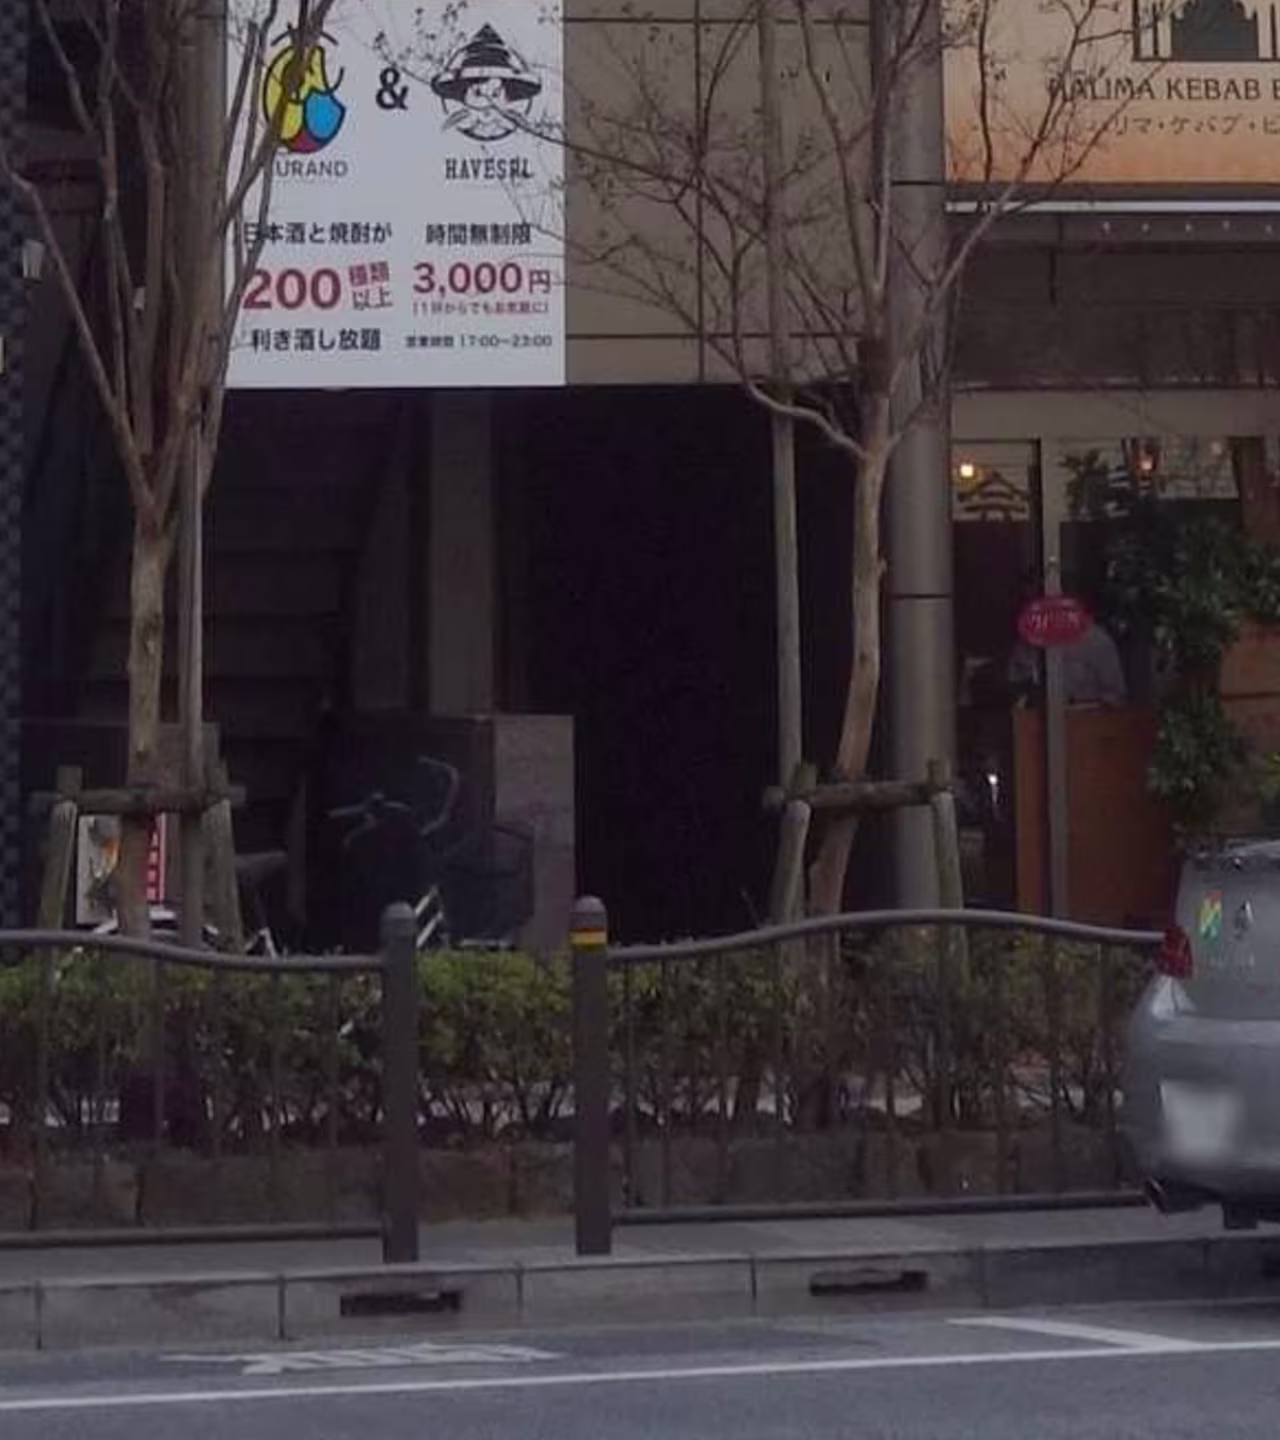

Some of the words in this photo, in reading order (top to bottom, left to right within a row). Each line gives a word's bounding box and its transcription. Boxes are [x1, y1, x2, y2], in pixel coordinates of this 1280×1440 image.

[376, 67, 408, 111] &
[1166, 76, 1261, 101] KEBAB
[426, 222, 531, 246] 時間無制限
[243, 267, 341, 310] 200
[252, 327, 382, 352] 利き酒し放題
